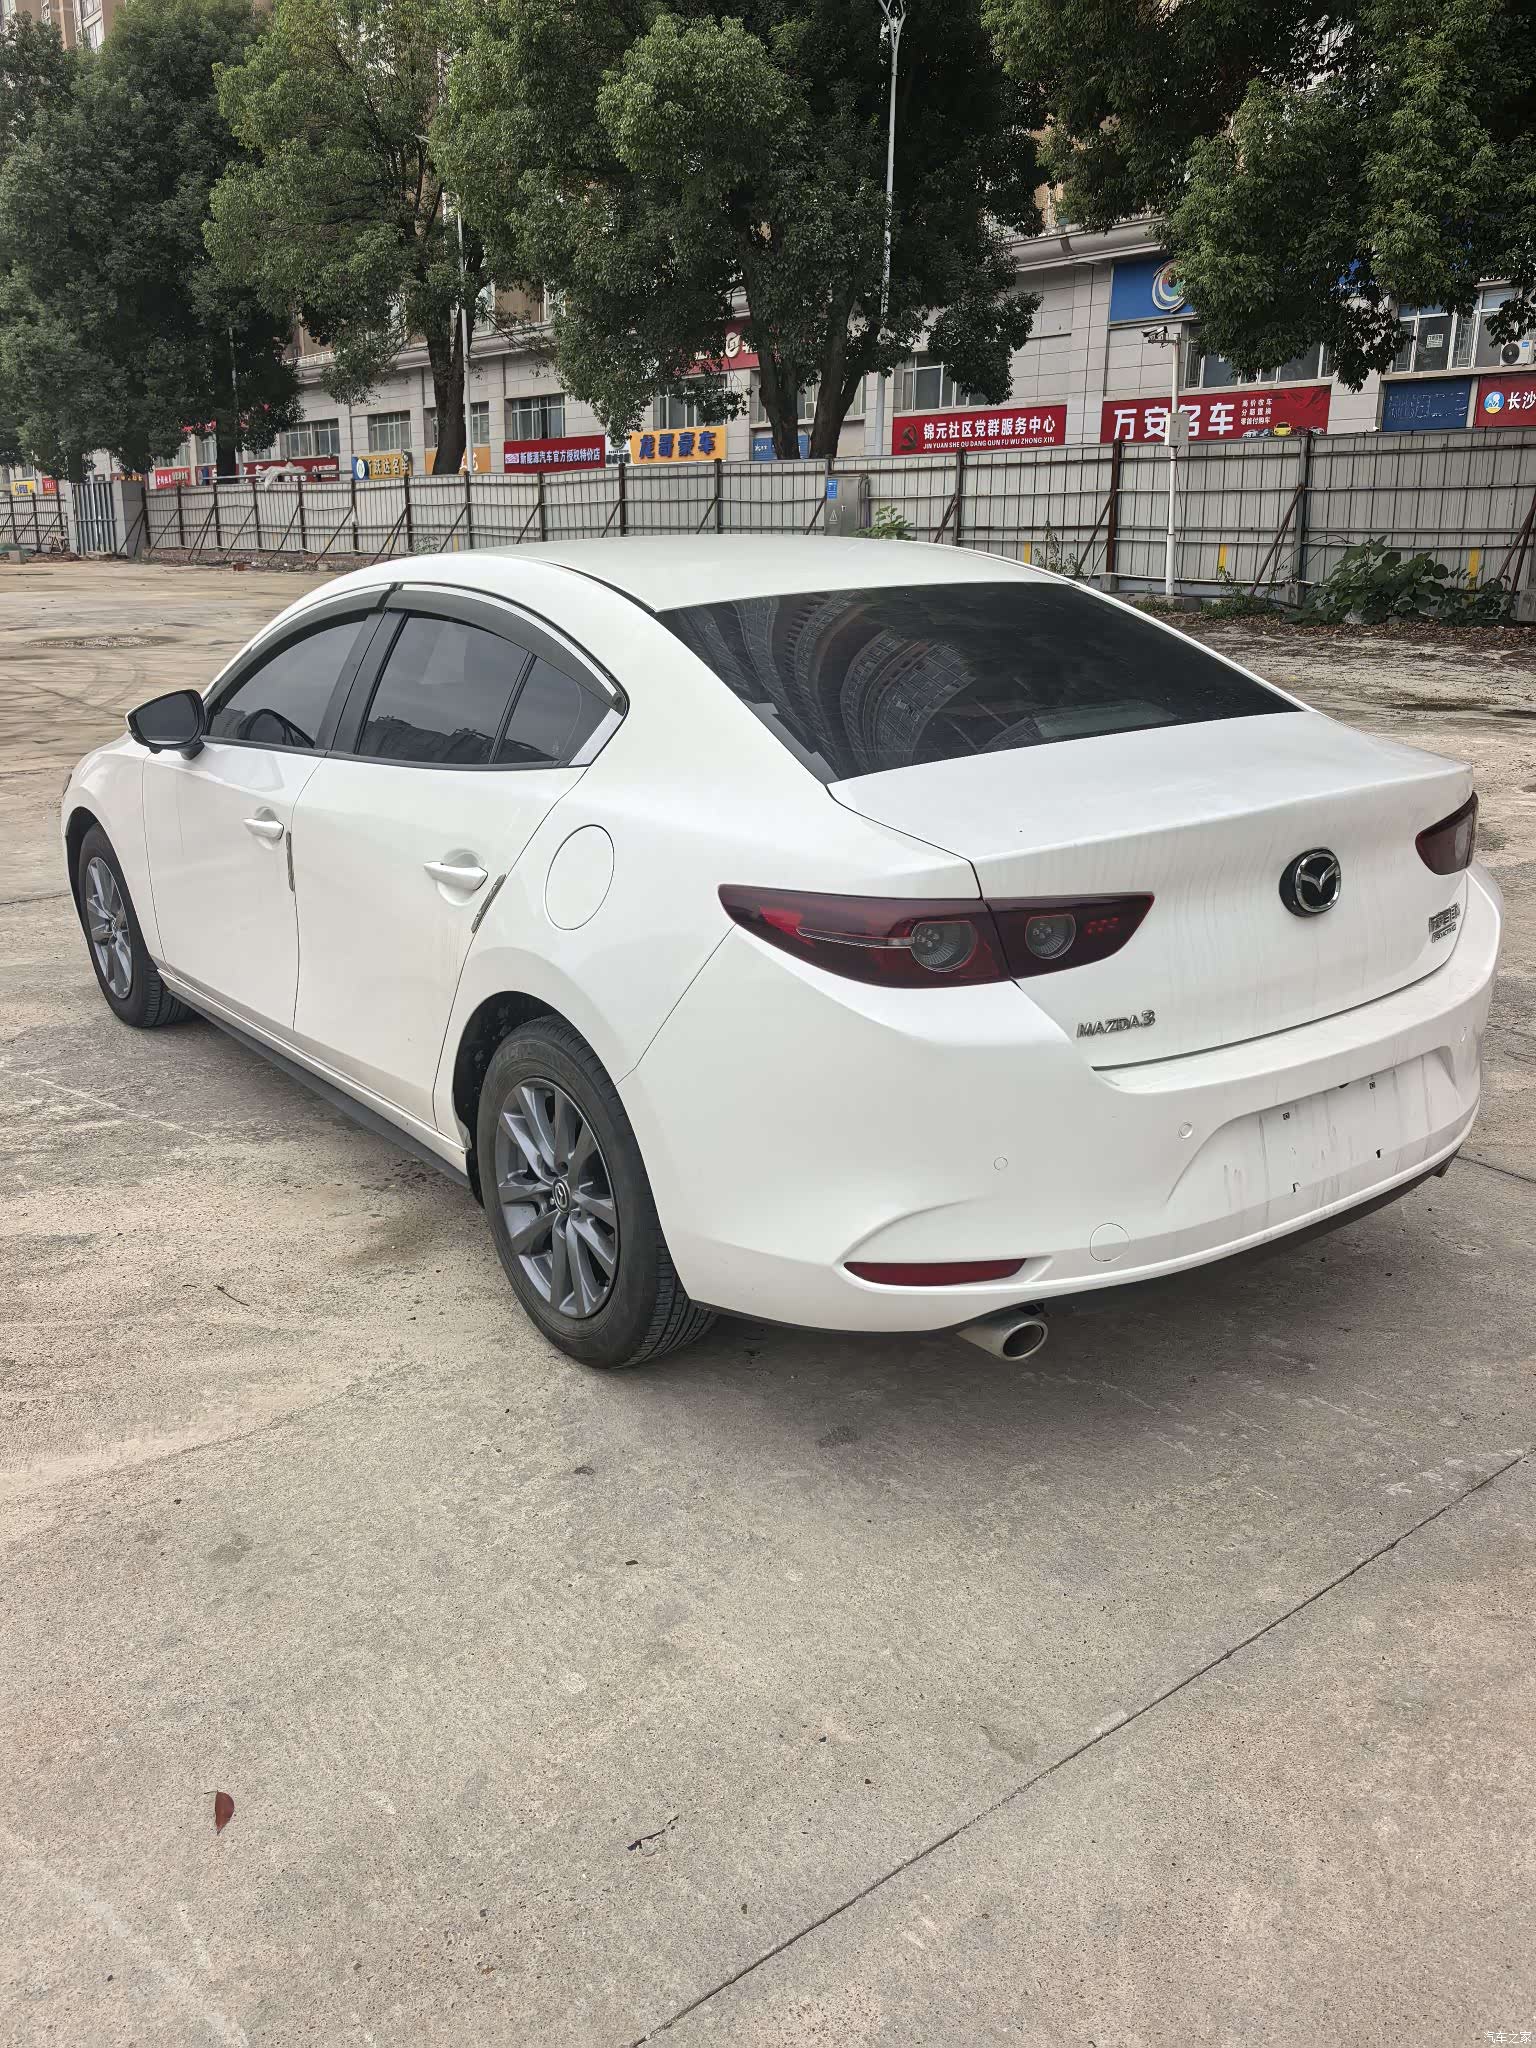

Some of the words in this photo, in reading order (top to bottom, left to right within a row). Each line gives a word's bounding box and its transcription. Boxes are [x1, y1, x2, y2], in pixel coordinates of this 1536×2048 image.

[1242, 398, 1273, 408] 高价收车
[1507, 391, 1536, 410] 长沙
[923, 415, 1056, 440] 锦元社区党群服务中心
[1114, 402, 1235, 440] 万安名车
[639, 431, 716, 460] 龙哥豪车
[961, 440, 970, 448] QU
[1010, 437, 1020, 445] WU
[1021, 437, 1043, 445] ZHONG
[519, 447, 601, 465] 新能源汽车官方授权特价店
